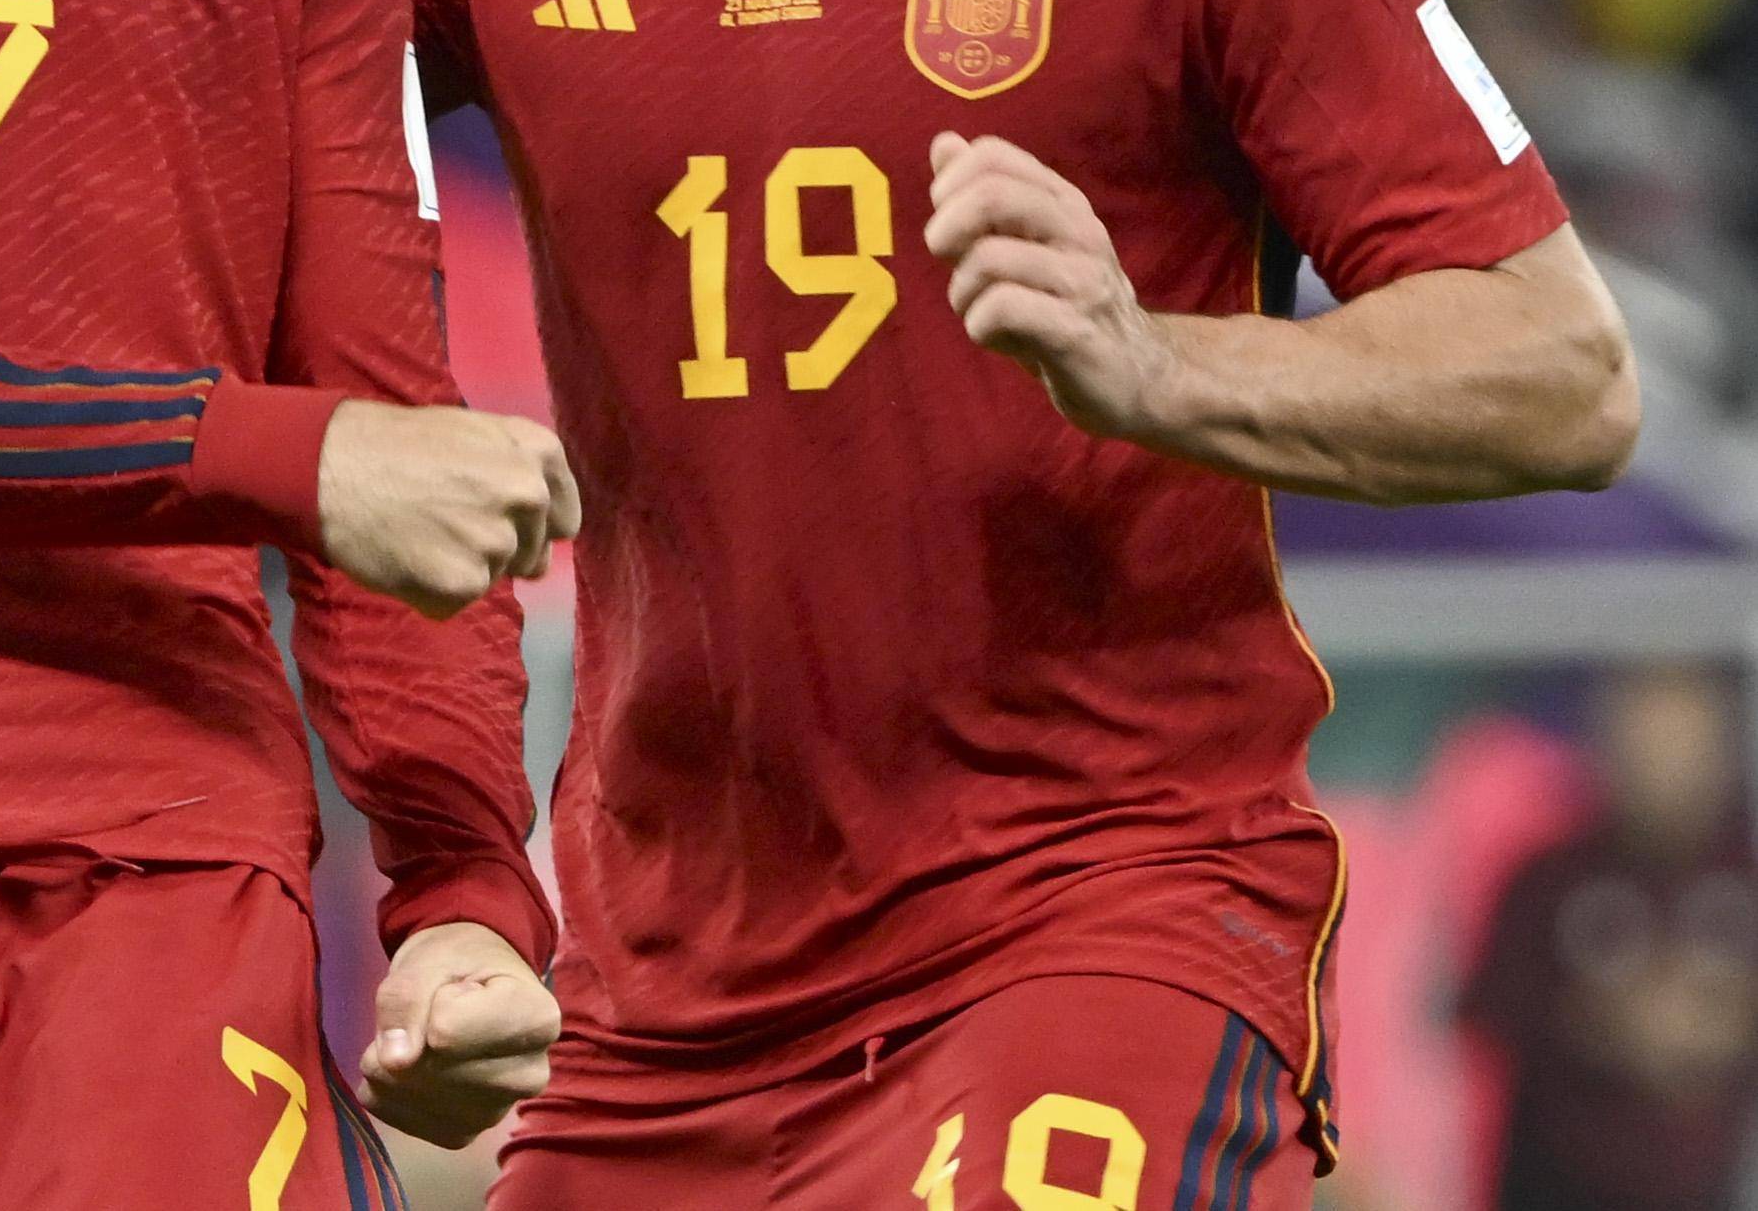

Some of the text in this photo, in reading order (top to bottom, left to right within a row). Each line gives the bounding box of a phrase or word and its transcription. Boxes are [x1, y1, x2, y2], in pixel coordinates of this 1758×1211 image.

[655, 146, 898, 400] 19
[221, 1025, 308, 1211] 7
[911, 1093, 1147, 1211] 19
